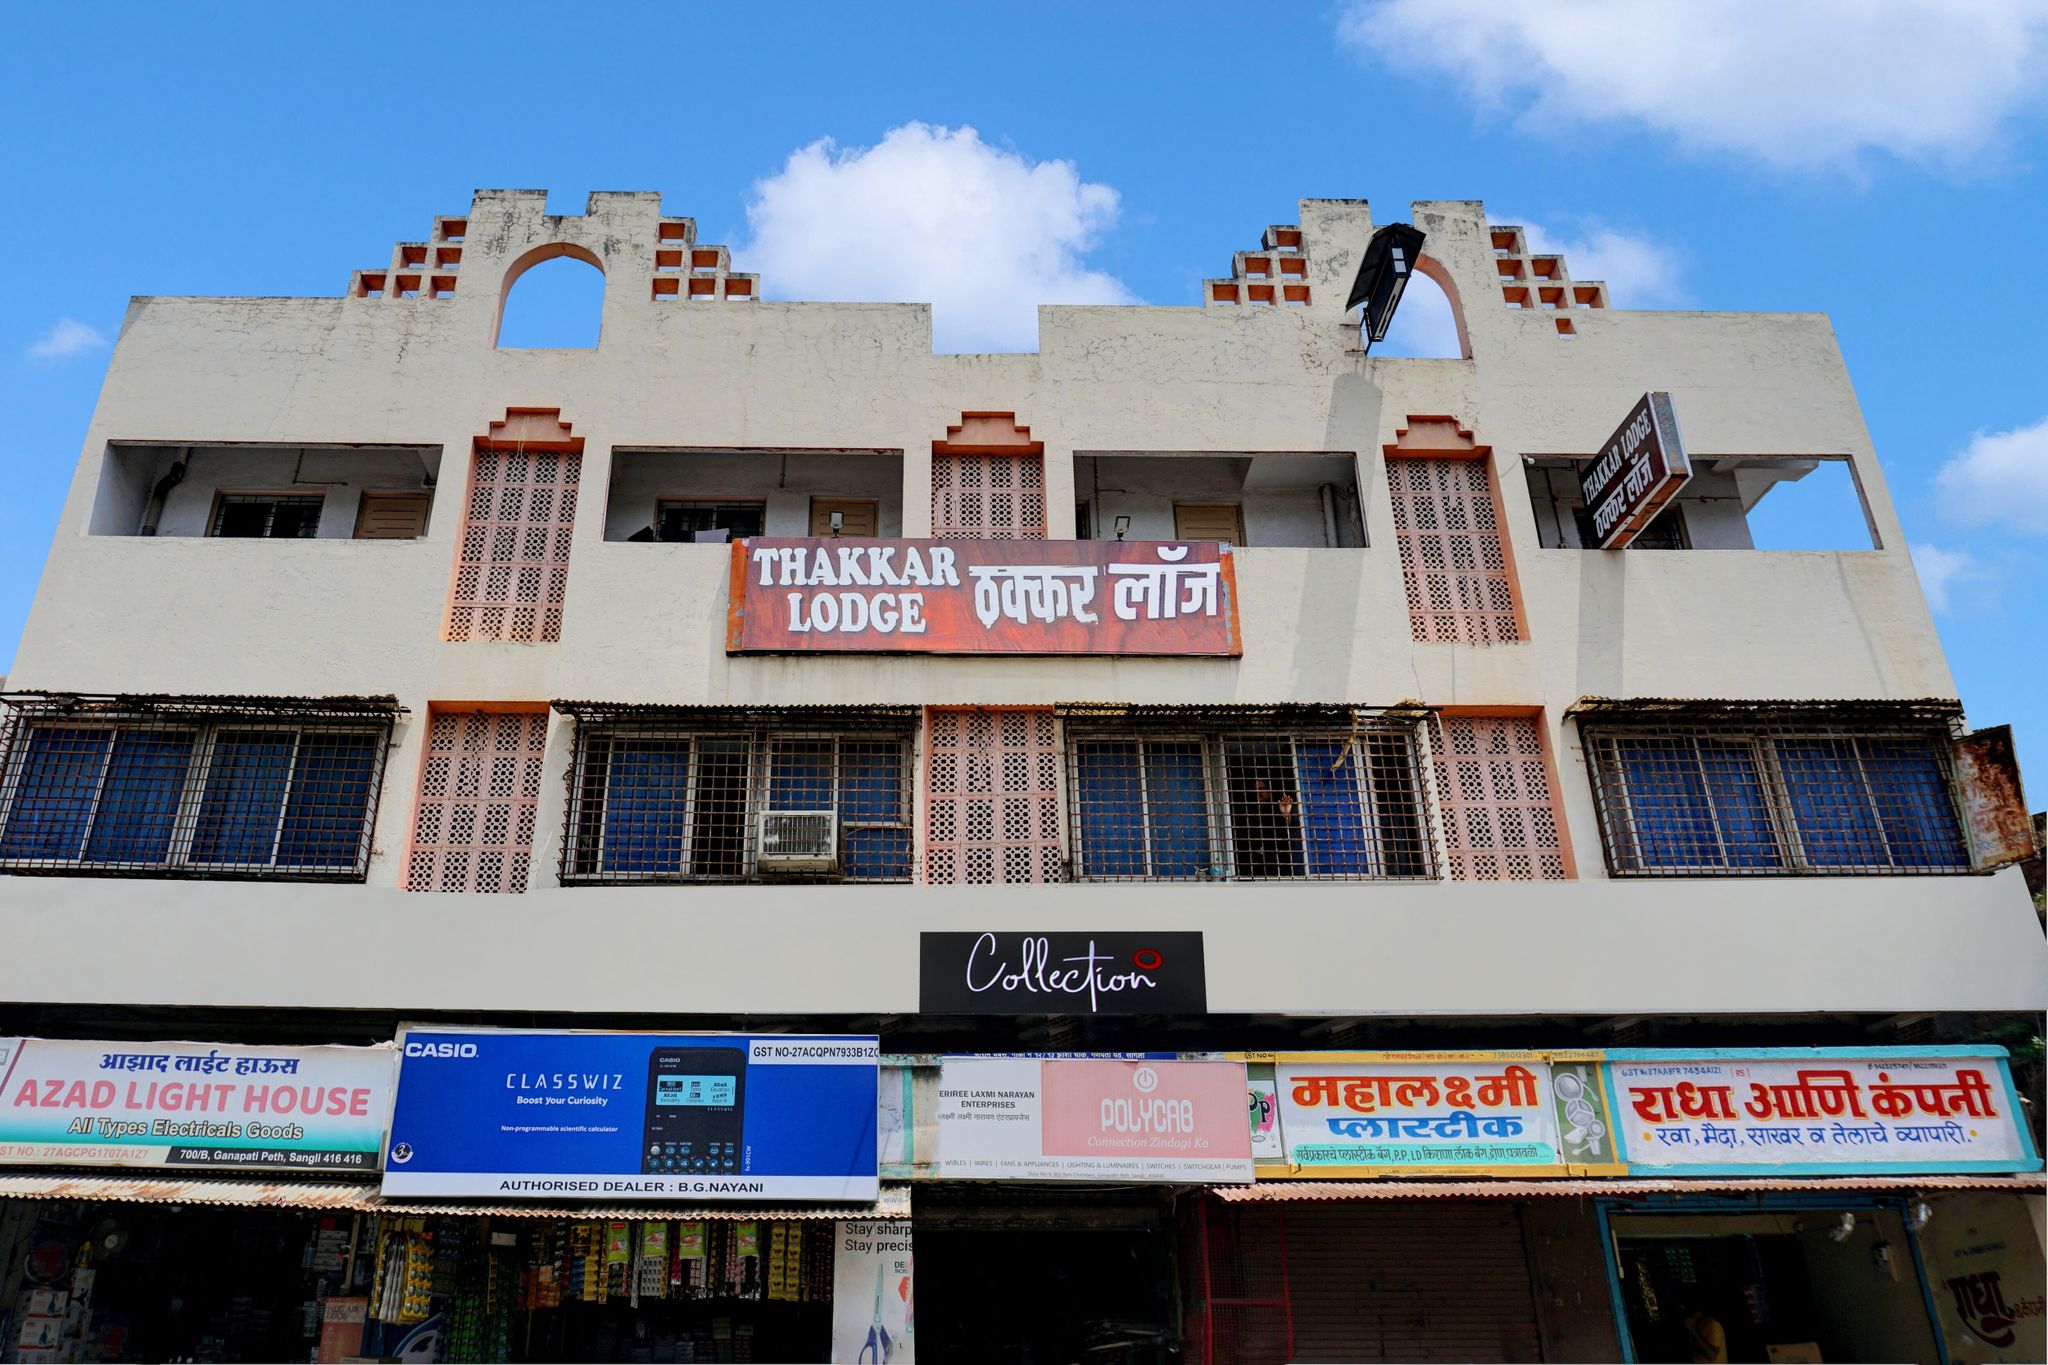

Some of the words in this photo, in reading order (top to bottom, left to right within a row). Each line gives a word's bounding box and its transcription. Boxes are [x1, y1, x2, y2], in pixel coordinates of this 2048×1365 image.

[1582, 445, 1622, 506] THAKKAR
[1621, 408, 1651, 460] LODGE
[1593, 482, 1627, 538] ठक्कर
[1624, 452, 1654, 503] लॉज
[753, 546, 960, 587] THAKKAR
[968, 565, 1099, 629] ठक्कर
[1108, 546, 1221, 620] लॉज
[787, 592, 926, 633] LODGE
[966, 932, 1157, 1013] Collection
[405, 1042, 478, 1058] CASIO
[753, 1047, 771, 1057] GST
[99, 1054, 170, 1073] आझाद
[174, 1050, 231, 1074] लाईट
[235, 1057, 300, 1075] हाऊस
[506, 1073, 623, 1090] CLASSWIZ
[1290, 1065, 1540, 1113] महालक्ष्मी
[13, 1079, 116, 1109] AZAD
[125, 1081, 236, 1112] LIGHT
[243, 1084, 371, 1116] HOUSE
[516, 1095, 543, 1105] Boost
[545, 1096, 565, 1105] Your
[567, 1096, 608, 1107] Curiosity
[970, 1090, 996, 1098] LAXMI
[1629, 1081, 1740, 1123] राधा
[1744, 1070, 1868, 1121] आणि
[1869, 1069, 2000, 1120] कंपनी
[1101, 1098, 1194, 1134] POLYCAB
[1326, 1111, 1523, 1139] प्लास्टीक
[67, 1117, 94, 1135] All
[98, 1118, 148, 1139] Types
[151, 1118, 242, 1138] Electricals
[246, 1121, 303, 1140] Goods
[501, 1125, 559, 1133] Non-programmable
[1746, 1127, 1805, 1146] साखर
[1807, 1127, 1826, 1144] व
[1830, 1122, 1889, 1145] तेलाचे
[1087, 1135, 1147, 1147] Connection
[1149, 1136, 1191, 1150] Zindagi
[1194, 1138, 1209, 1148] Ka
[180, 1149, 211, 1161] 700/B,
[213, 1150, 259, 1162] Ganapati
[261, 1152, 286, 1163] Peth,
[289, 1152, 321, 1164] Sangli
[323, 1153, 341, 1163] 416
[344, 1154, 362, 1164] 416
[1066, 1161, 1096, 1169] LIGHTING
[1183, 1163, 1221, 1171] SWITCHGEAR
[500, 1181, 599, 1192] AUTHORISED
[603, 1182, 664, 1192] DEALER
[678, 1182, 764, 1193] B.G.NAYANI
[845, 1223, 873, 1237] Stay
[877, 1223, 913, 1237] sharp
[845, 1239, 873, 1254] Stay
